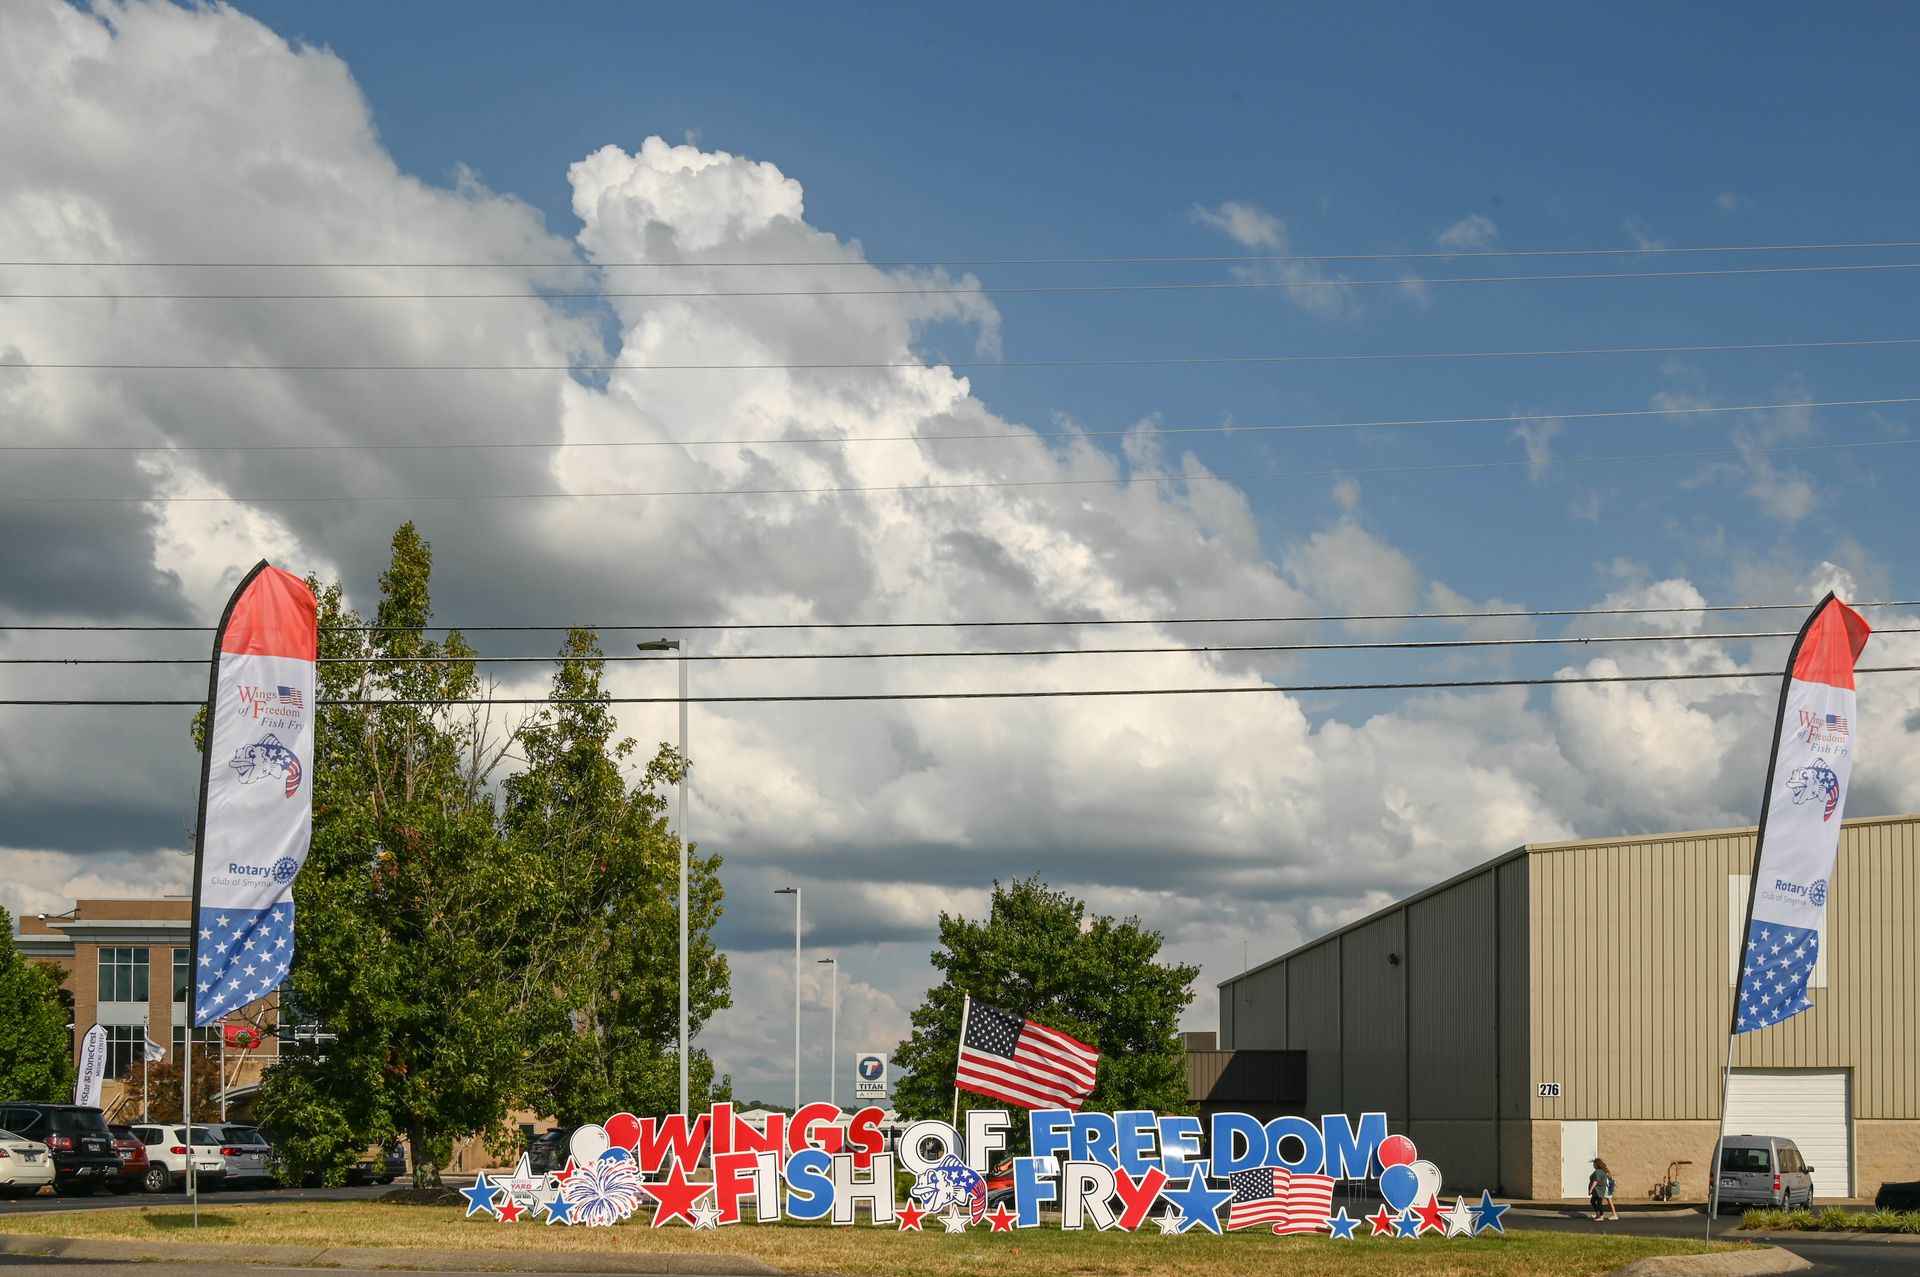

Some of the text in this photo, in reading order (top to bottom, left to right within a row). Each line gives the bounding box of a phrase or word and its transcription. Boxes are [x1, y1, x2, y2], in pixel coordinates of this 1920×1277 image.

[236, 685, 277, 704] Wings
[238, 700, 300, 720] of Freedom
[1798, 710, 1825, 728] Wing
[261, 717, 284, 729] Fish
[1798, 725, 1845, 743] of Freedom
[1811, 743, 1831, 753] Fish
[228, 863, 271, 877] Rotary
[211, 877, 272, 888] Club of Smyrna
[1775, 880, 1808, 896] Rotary
[81, 1032, 97, 1106] riStar StoneCrest
[1540, 1084, 1559, 1096] 276
[638, 1101, 1387, 1179] WINGS OF FREEDOM
[714, 1148, 1169, 1232] FISH FRY
